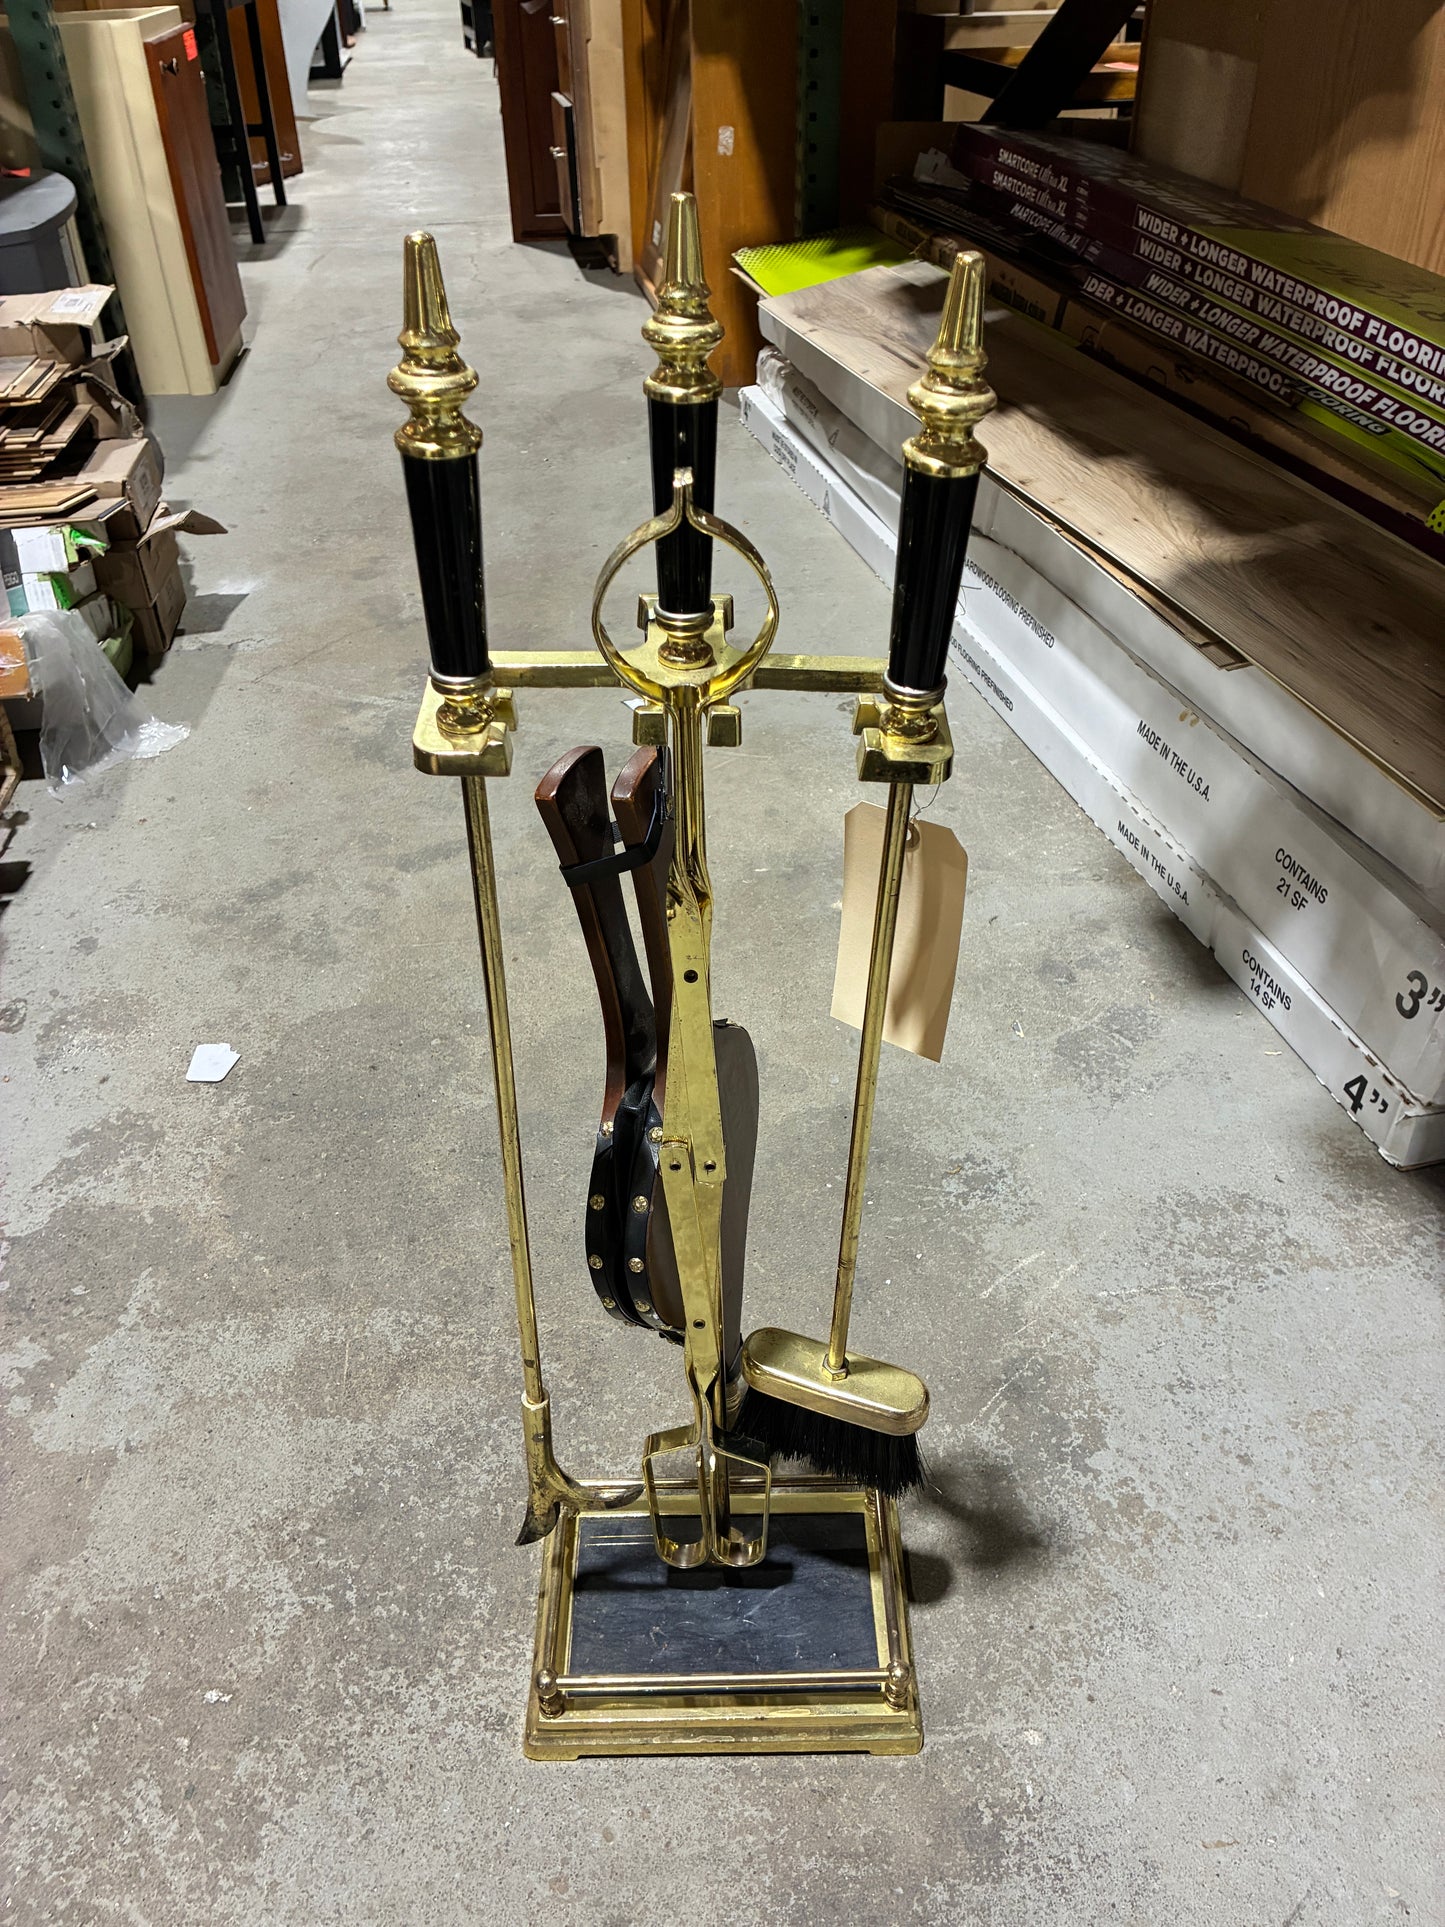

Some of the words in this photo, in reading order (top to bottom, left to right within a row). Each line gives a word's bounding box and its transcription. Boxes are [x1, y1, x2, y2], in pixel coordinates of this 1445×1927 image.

[992, 170, 1038, 202] SMARTCORE
[1056, 199, 1068, 217] XL
[998, 148, 1040, 179] SMARTCORE
[1057, 175, 1069, 193] XL
[1010, 203, 1054, 233] MARTCORE
[1138, 209, 1178, 244] WIDER
[1190, 235, 1248, 277] LONGER
[1251, 261, 1365, 331] WATERPROOF
[1124, 299, 1184, 341] LONGER
[1139, 237, 1182, 272] WIDER
[1194, 264, 1255, 307] LONGER
[1257, 293, 1375, 363] WATERPROOF
[1375, 355, 1445, 405] FLOOR
[1146, 273, 1192, 308] WIDER
[1198, 301, 1260, 342] LONGER
[1256, 329, 1379, 405] WATERPROOF
[964, 558, 994, 589] ARDWOOD
[993, 581, 1019, 615] FLOORING
[1018, 606, 1055, 649] PREFINISHED
[1137, 720, 1160, 752] MADE
[1159, 744, 1171, 761] IN
[1170, 751, 1189, 778] THE
[1187, 768, 1210, 802] U.S.A.
[1117, 820, 1140, 852] MADE
[1140, 844, 1150, 861] IN
[1151, 854, 1166, 880] THE
[1167, 873, 1190, 906] U.S.A.
[1275, 848, 1329, 905] CONTAINS
[1276, 877, 1291, 898] 21
[1290, 892, 1309, 911] SF
[1242, 949, 1293, 1011] CONTAINS
[1250, 978, 1261, 998] 14
[1261, 992, 1277, 1011] SF
